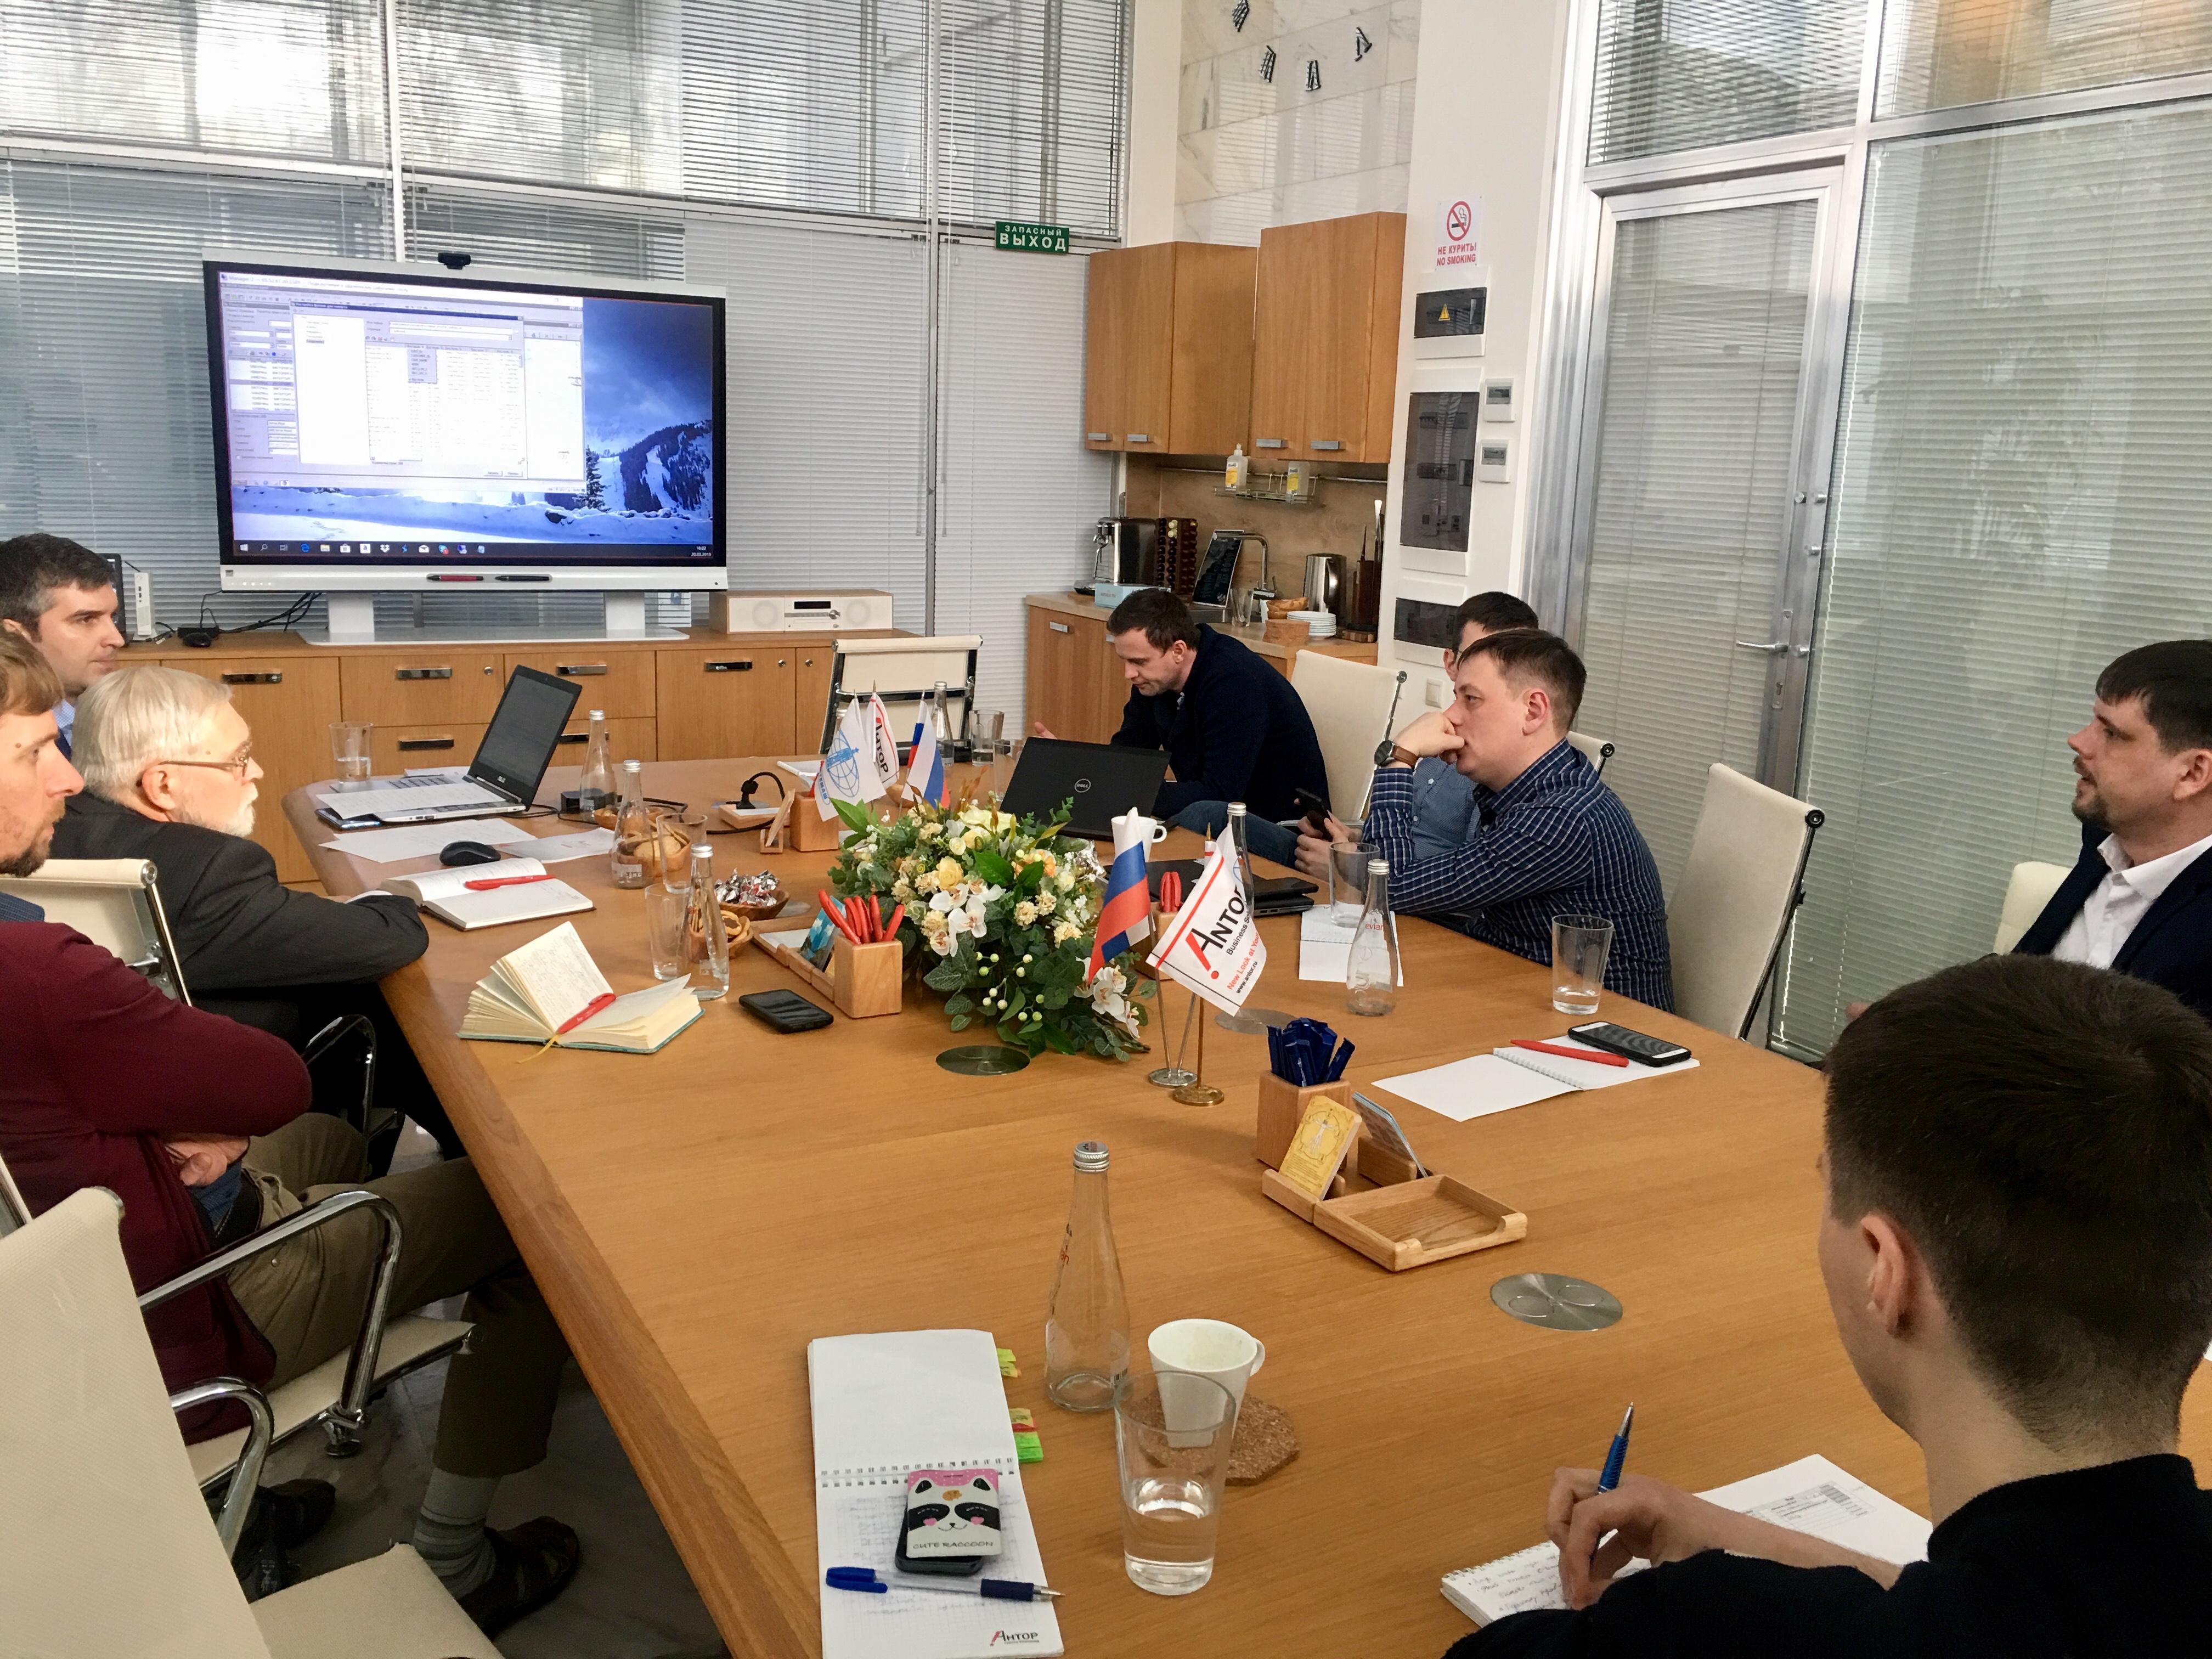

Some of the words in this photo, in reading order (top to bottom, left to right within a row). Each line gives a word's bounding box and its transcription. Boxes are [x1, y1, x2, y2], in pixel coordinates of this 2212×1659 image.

[1005, 225, 1062, 236] ЗАПАСНЫЙ
[1000, 233, 1066, 252] ВЫХОД
[1437, 246, 1447, 255] НЕ
[1448, 242, 1477, 253] КУРИТЬ!
[1436, 257, 1446, 266] NO
[1447, 253, 1476, 265] SMOKING
[1226, 923, 1248, 956] Business
[1227, 973, 1240, 990] New
[1239, 956, 1251, 973] Look
[1248, 948, 1256, 958] at
[1235, 961, 1258, 994] www.antor.ru
